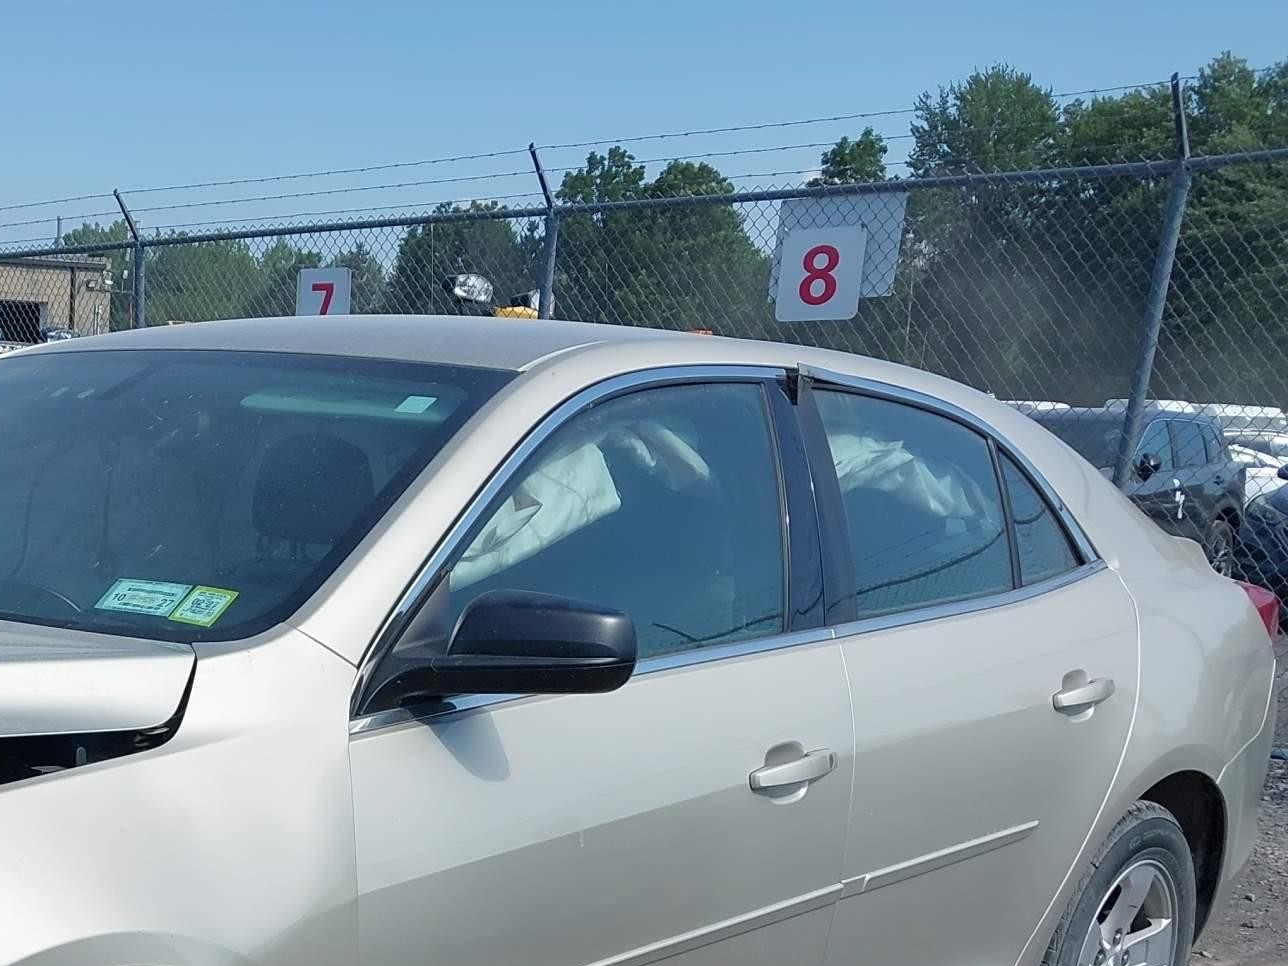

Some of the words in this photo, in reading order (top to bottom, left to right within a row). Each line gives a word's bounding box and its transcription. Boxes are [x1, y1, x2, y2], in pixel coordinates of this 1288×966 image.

[799, 244, 840, 306] 8
[311, 282, 334, 316] 7
[112, 592, 127, 602] 10
[157, 598, 175, 608] 27
